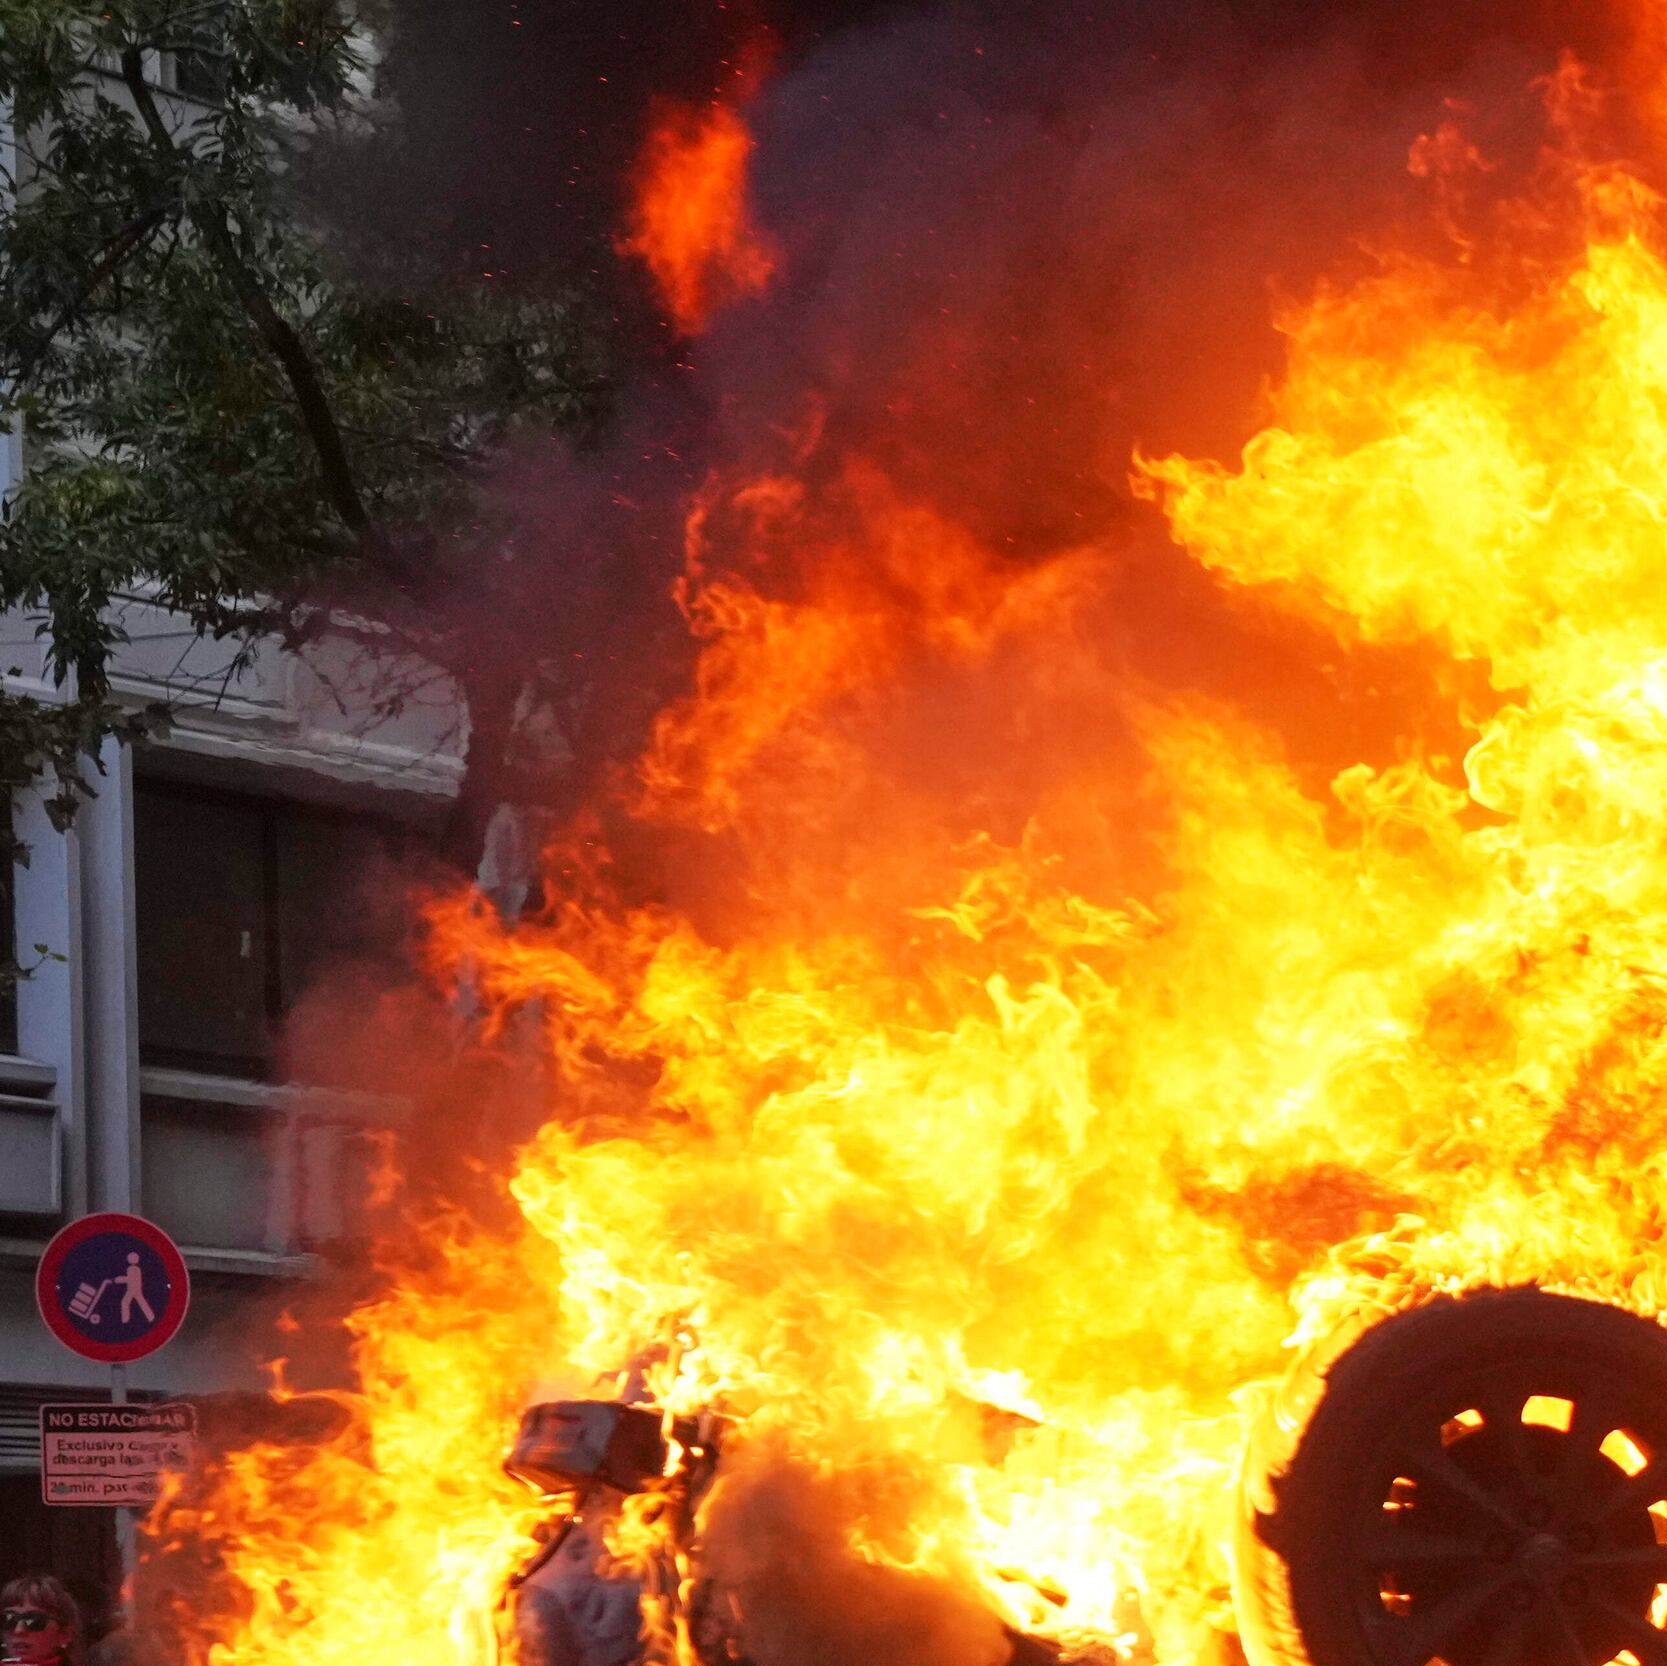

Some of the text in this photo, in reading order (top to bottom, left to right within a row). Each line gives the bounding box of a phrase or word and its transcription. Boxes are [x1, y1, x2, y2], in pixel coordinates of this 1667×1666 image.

[49, 1413, 185, 1428] NO ESTACAR
[57, 1439, 124, 1452] Exclusivo
[52, 1454, 116, 1467] descarga
